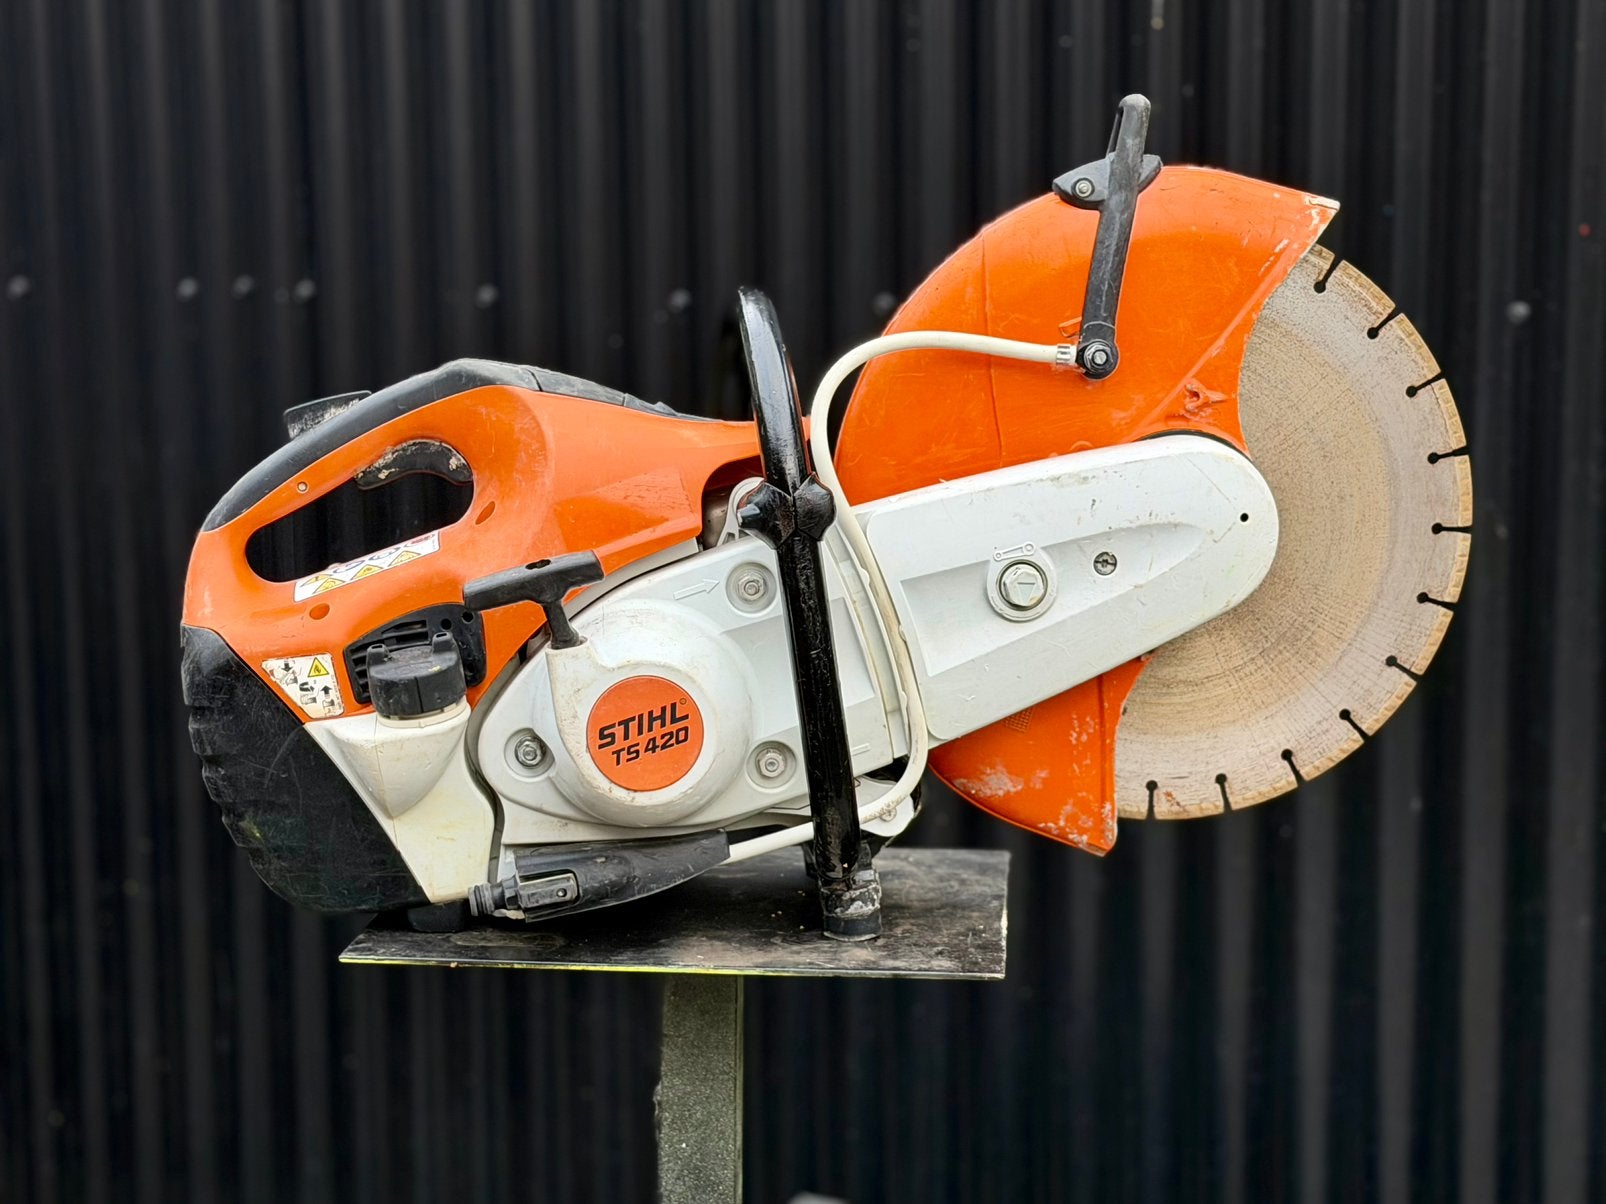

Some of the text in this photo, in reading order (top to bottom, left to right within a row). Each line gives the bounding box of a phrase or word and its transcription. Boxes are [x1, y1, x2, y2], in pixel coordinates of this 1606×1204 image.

[598, 702, 689, 750] STIHL
[611, 726, 689, 767] TS 420
